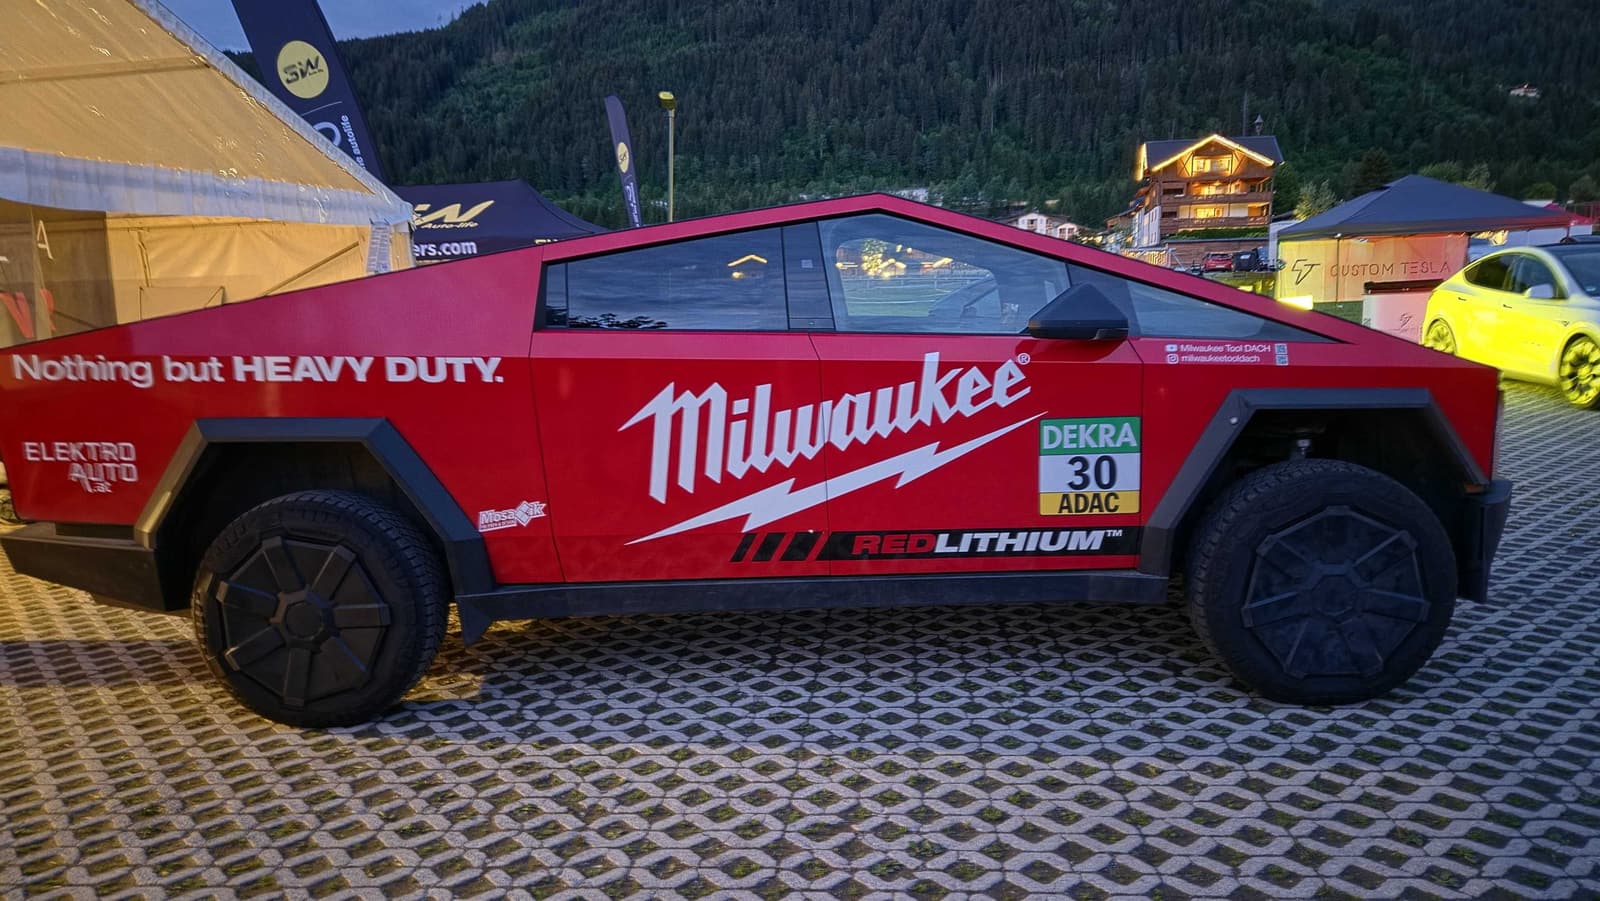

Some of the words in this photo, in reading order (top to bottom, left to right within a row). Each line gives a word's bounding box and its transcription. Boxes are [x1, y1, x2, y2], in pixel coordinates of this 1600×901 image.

[341, 114, 361, 155] autolife
[413, 241, 478, 257] ers.com
[1329, 262, 1395, 277] CUSTOM
[1400, 260, 1452, 274] TESLA
[1180, 344, 1224, 352] Milwaukee
[1225, 344, 1243, 352] Tool
[1244, 344, 1271, 352] DACH
[11, 353, 155, 388] Nothing
[163, 355, 226, 382] but
[231, 356, 374, 382] HEAVY
[384, 356, 504, 383] DUTY.
[1043, 421, 1138, 450] DEKRA
[23, 441, 136, 462] ELEKTRO
[68, 463, 138, 482] AUTO
[1066, 454, 1117, 491] 30
[1057, 492, 1120, 514] ADAC
